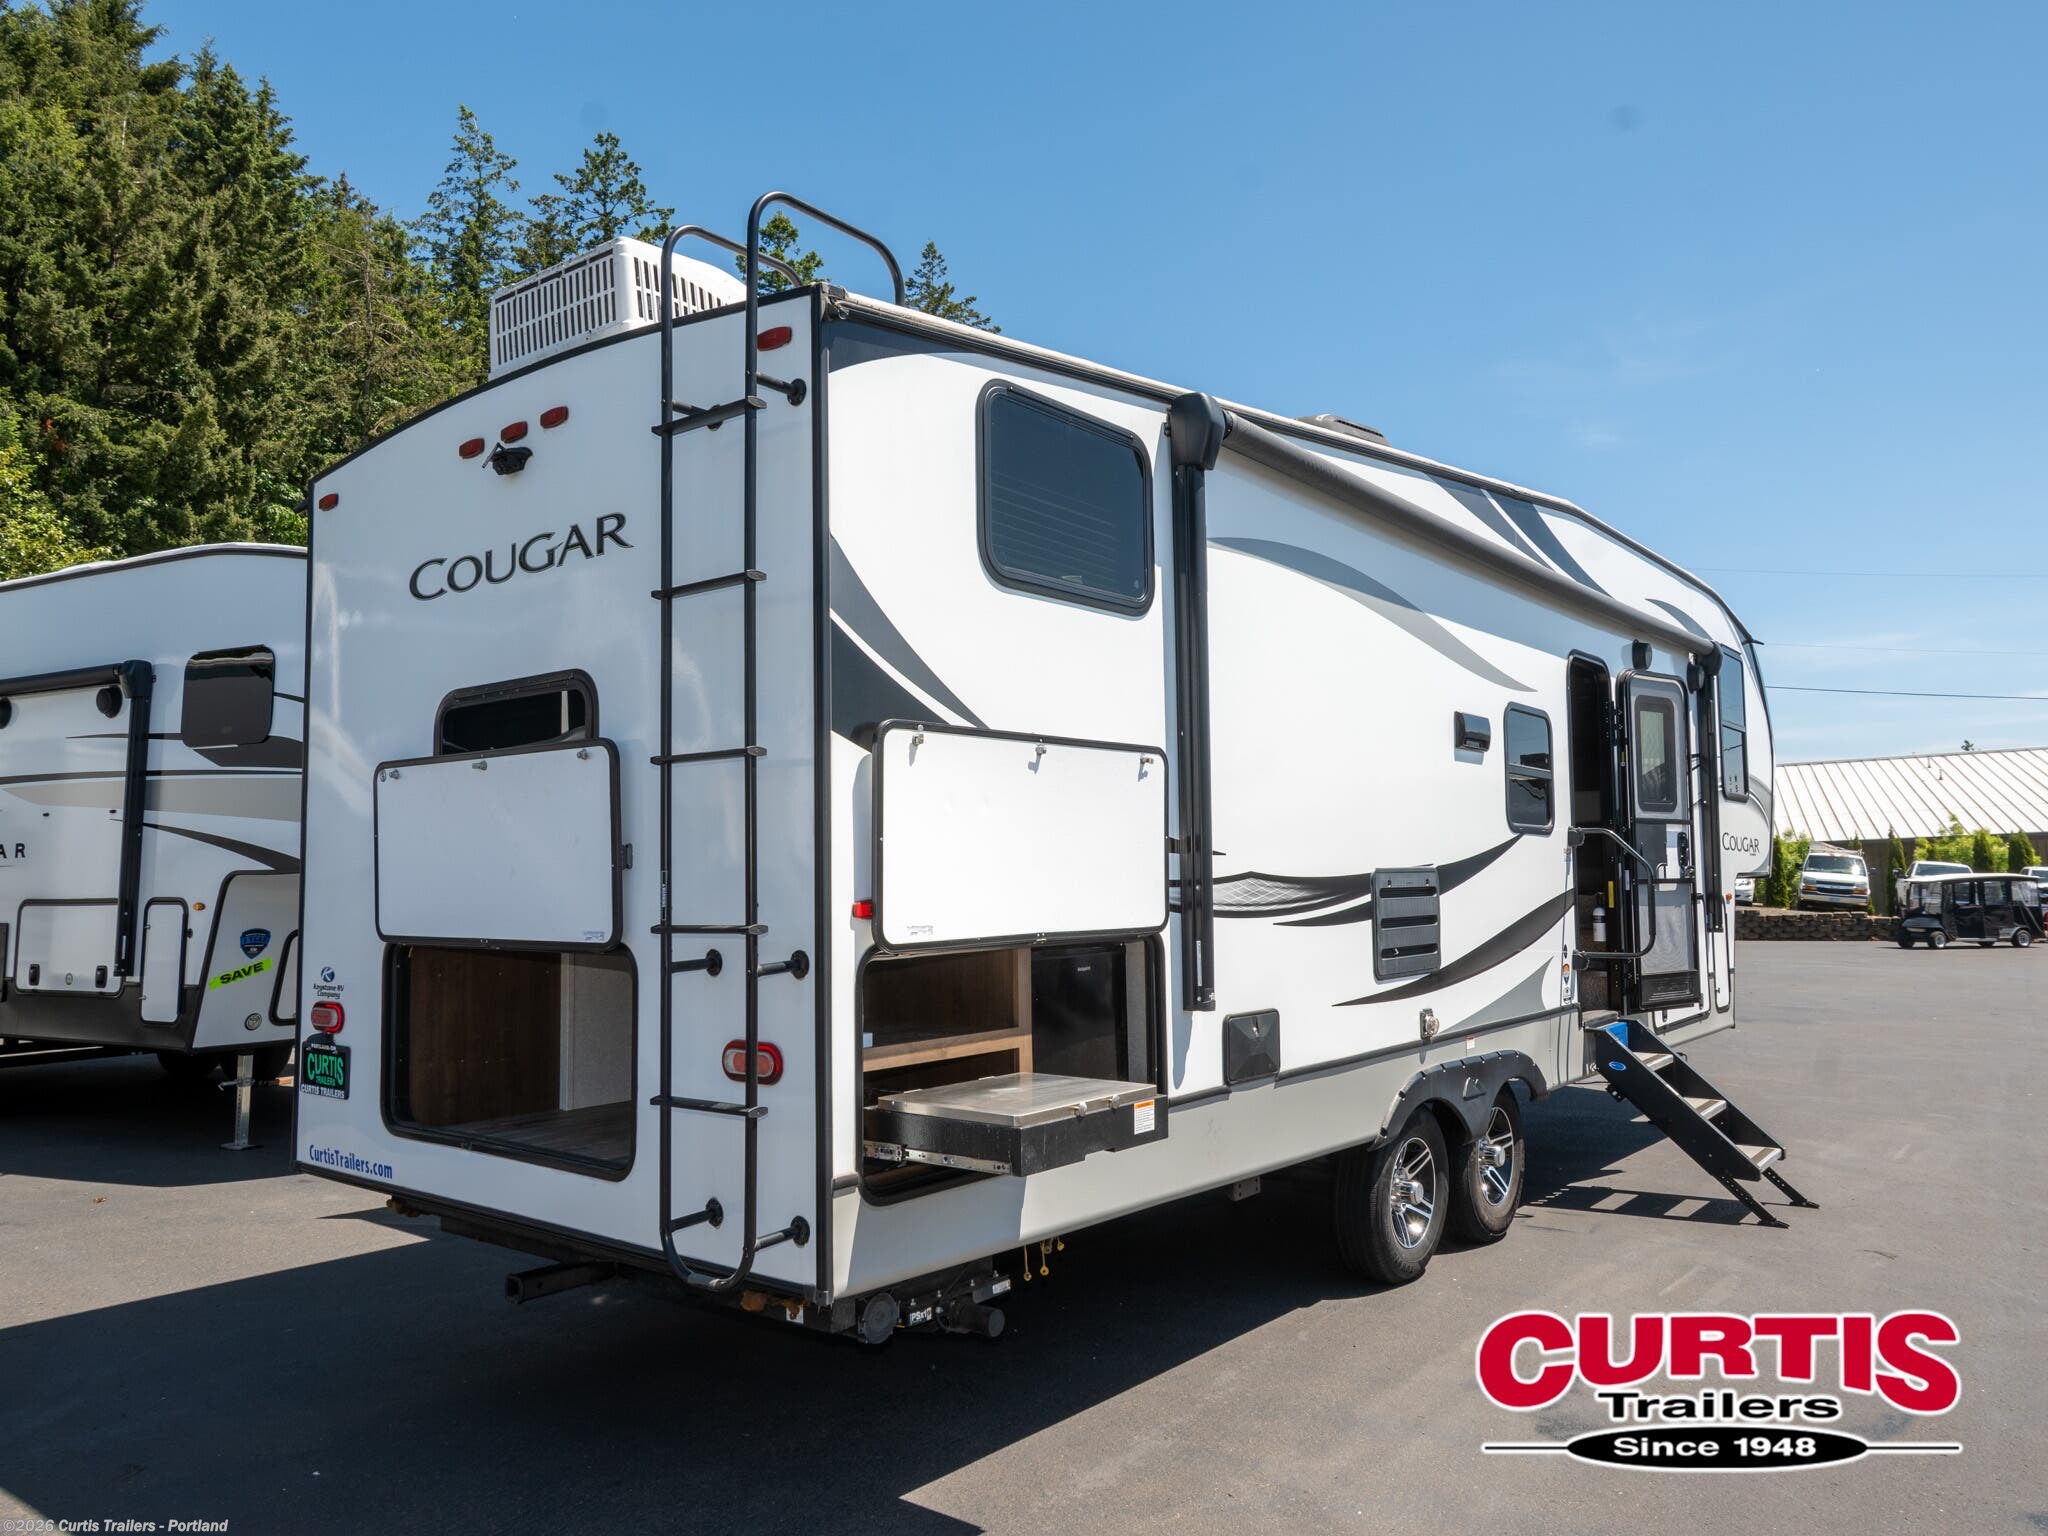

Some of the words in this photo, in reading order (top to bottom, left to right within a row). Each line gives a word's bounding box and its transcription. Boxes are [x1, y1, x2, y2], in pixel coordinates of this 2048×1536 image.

[409, 511, 635, 601] COUGAR
[1721, 832, 1760, 853] COUGAR
[219, 961, 265, 985] SAVE
[307, 1052, 344, 1086] CURTIS
[320, 1087, 345, 1099] TRAILERS
[309, 1144, 393, 1179] CurtisTrailers.com
